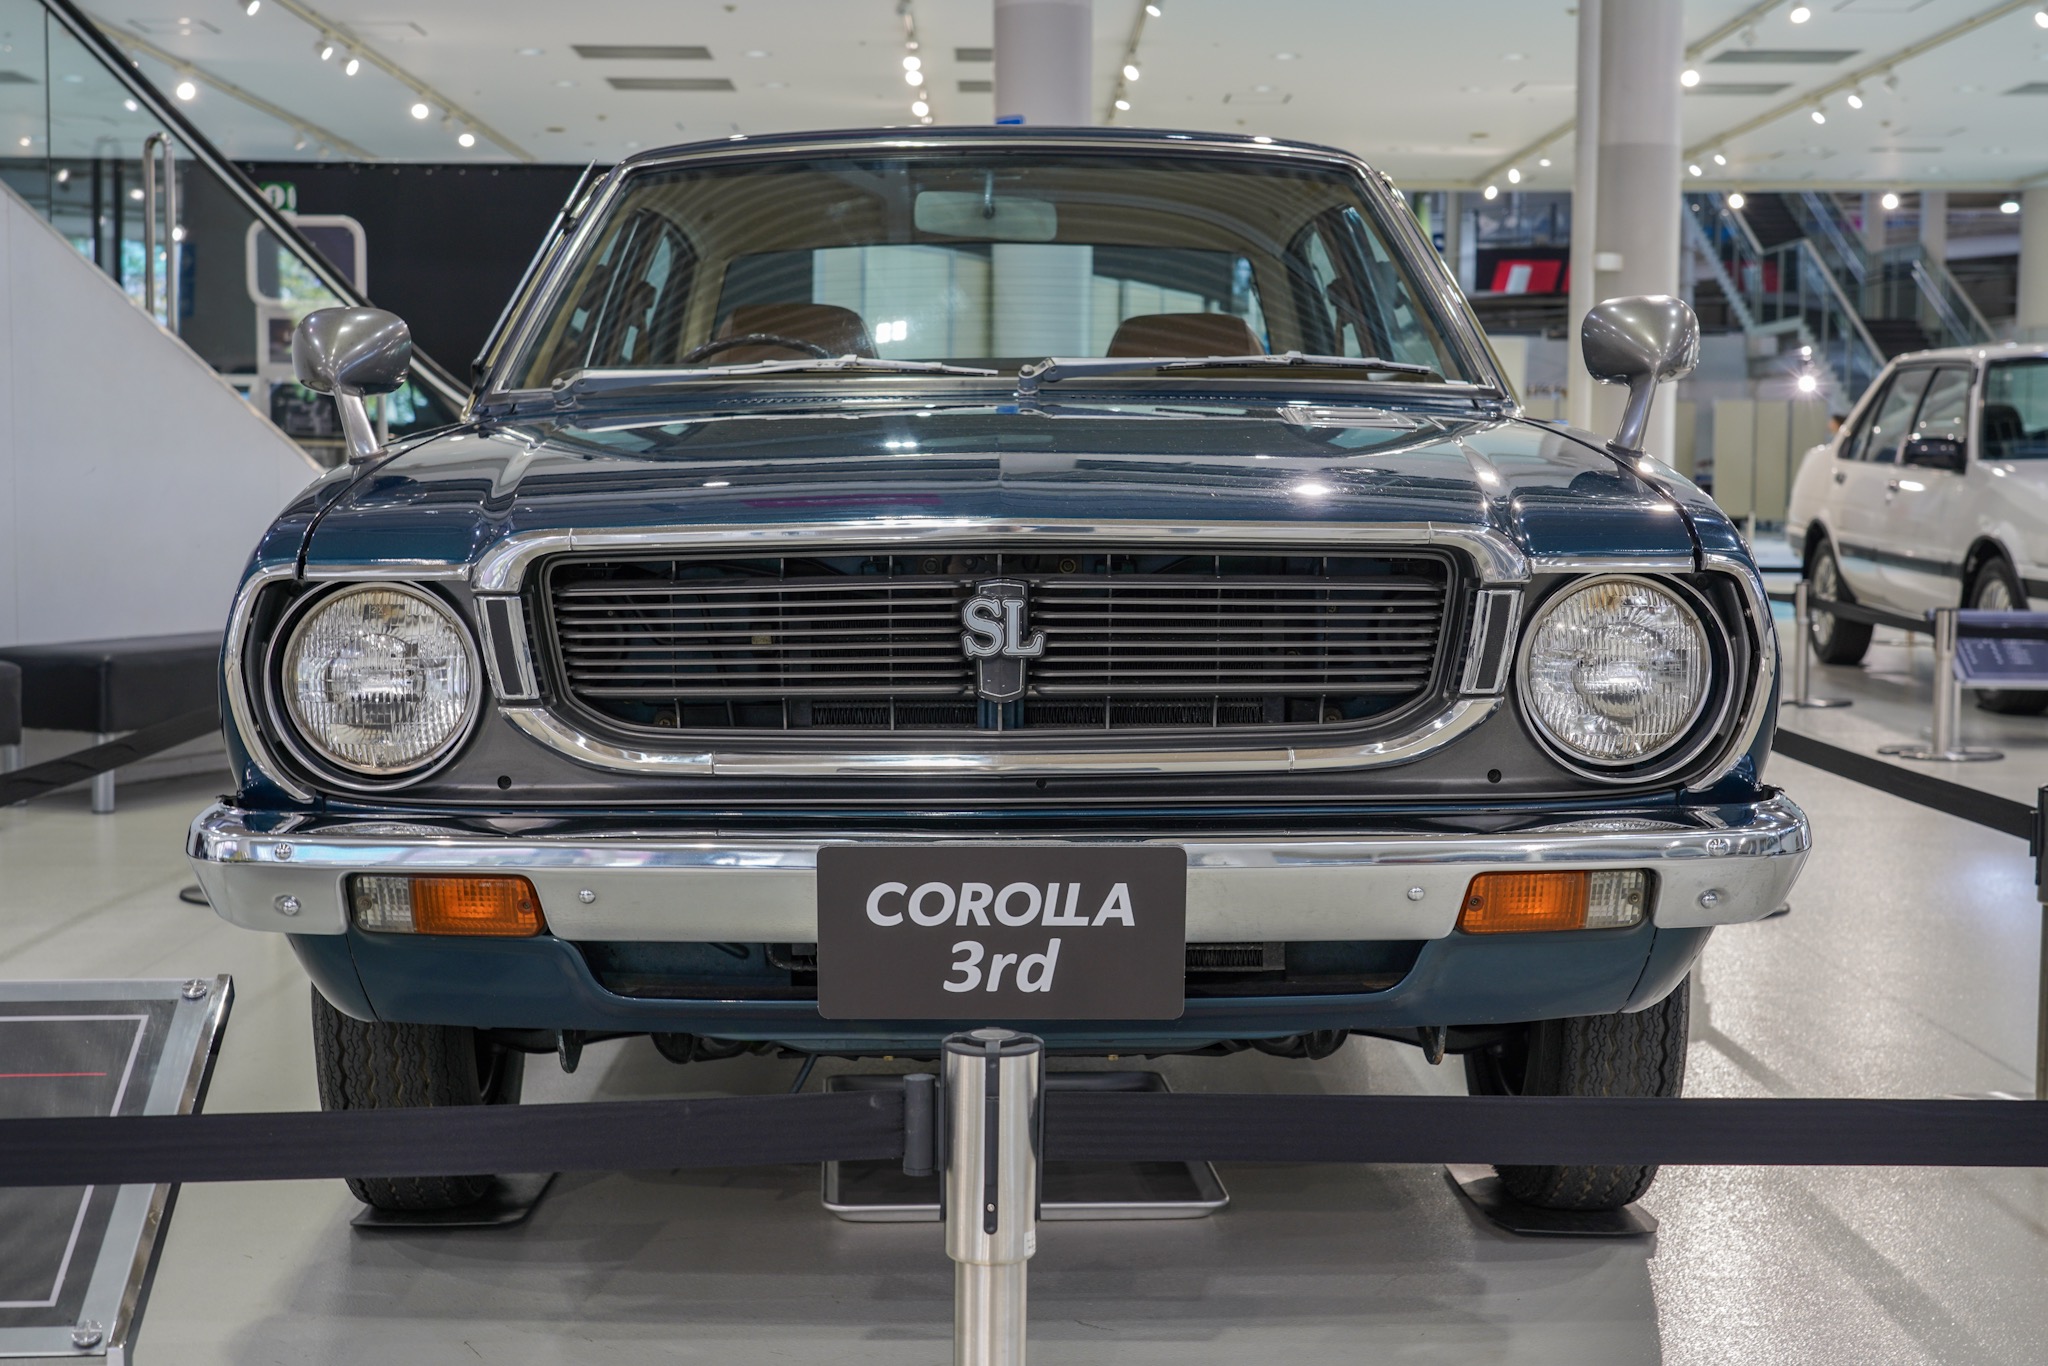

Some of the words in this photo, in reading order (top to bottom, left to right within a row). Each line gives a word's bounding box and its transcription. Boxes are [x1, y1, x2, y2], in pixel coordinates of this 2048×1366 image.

[963, 598, 1044, 657] SL
[866, 881, 1135, 927] COROLLA
[943, 938, 1062, 993] 3rd
